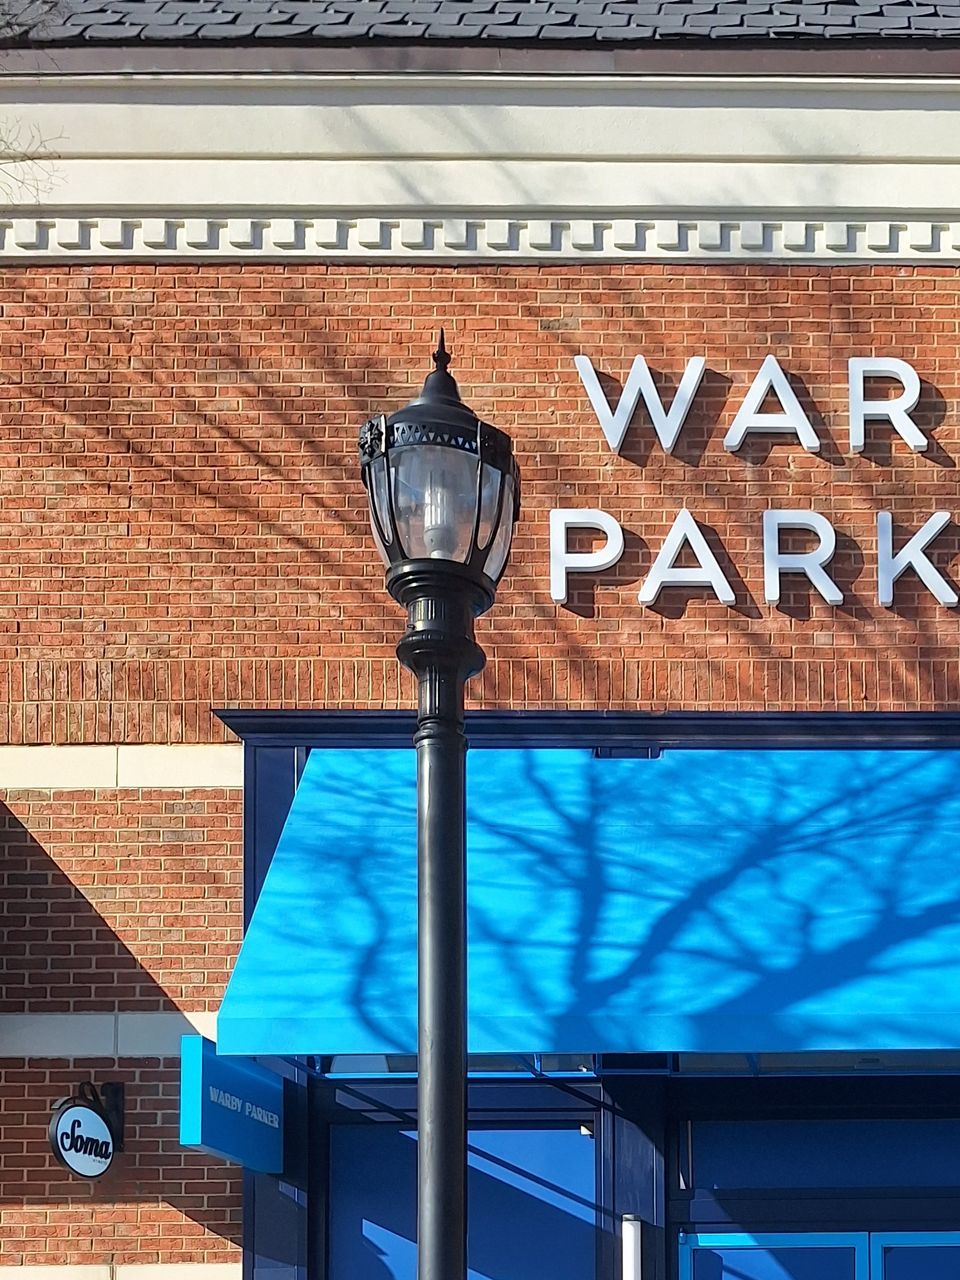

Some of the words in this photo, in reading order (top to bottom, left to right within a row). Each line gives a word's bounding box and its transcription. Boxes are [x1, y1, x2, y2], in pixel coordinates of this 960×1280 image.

[209, 1086, 243, 1113] WARBY
[245, 1102, 280, 1129] PARKER
[60, 1119, 112, 1160] Soma
